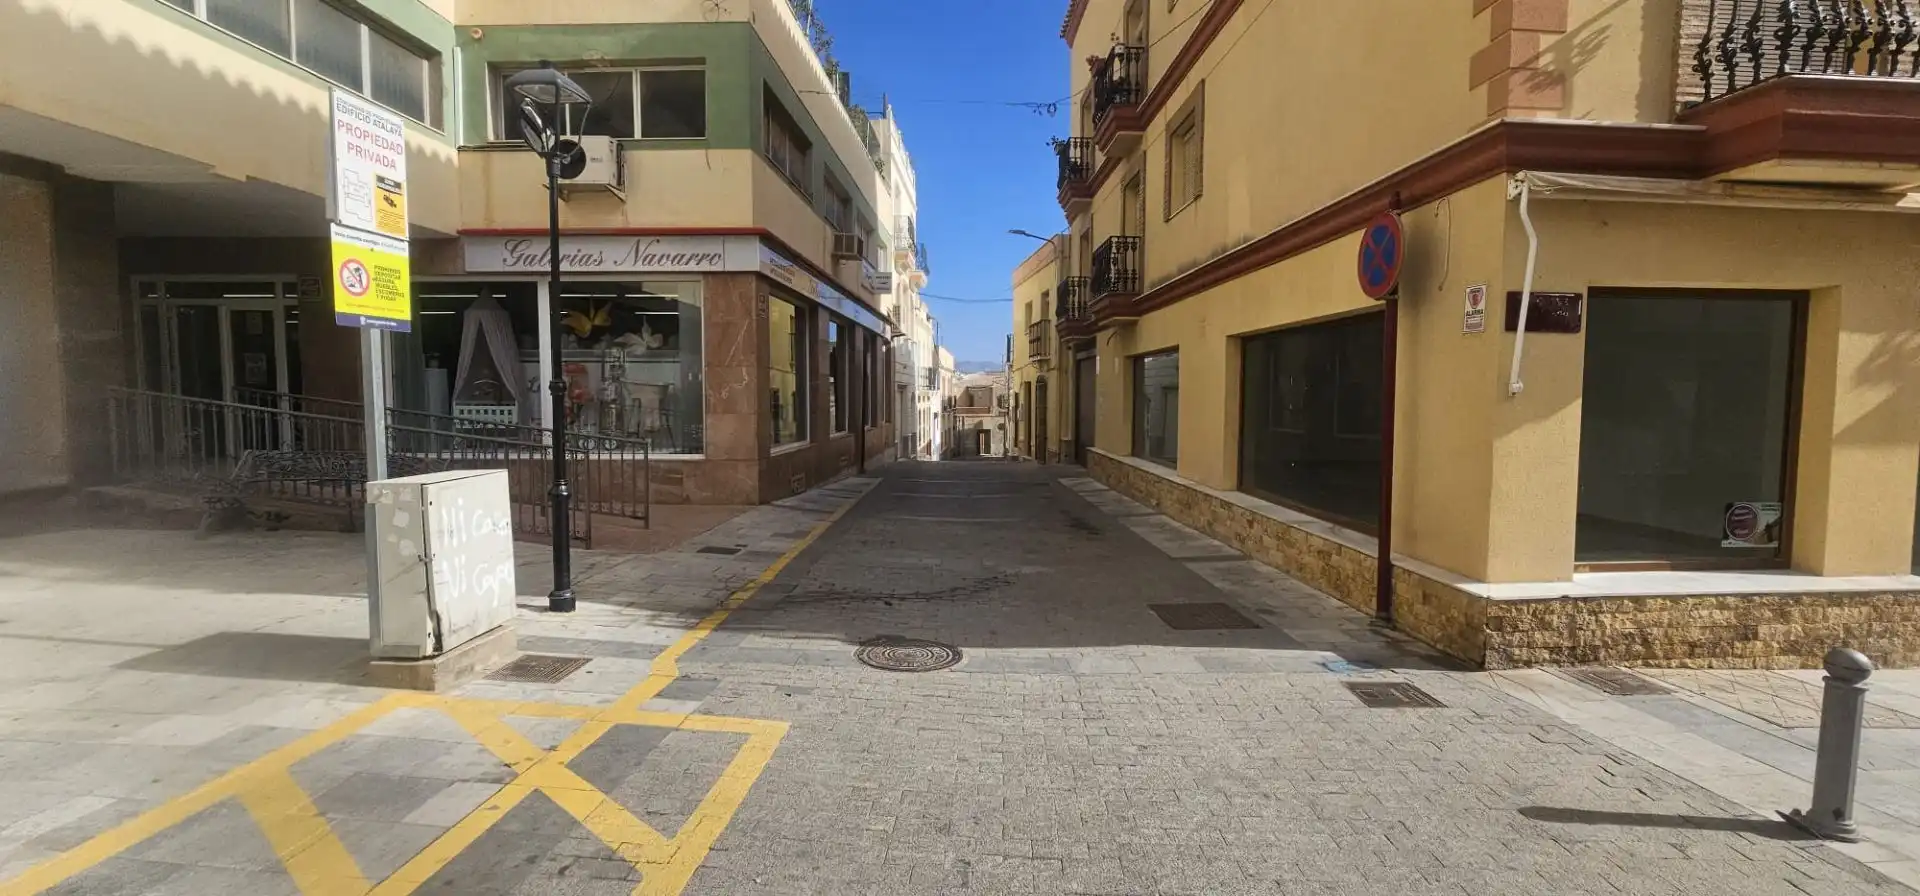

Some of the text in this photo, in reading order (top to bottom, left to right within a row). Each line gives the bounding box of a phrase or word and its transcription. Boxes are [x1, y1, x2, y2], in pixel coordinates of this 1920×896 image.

[336, 103, 403, 138] EDIFICIO ATALAYA
[337, 119, 403, 155] PROPIEDAD
[346, 141, 397, 172] PRIVADA
[503, 238, 722, 267] Galrias Navarro
[442, 497, 467, 548] Ni
[442, 554, 467, 600] Ni
